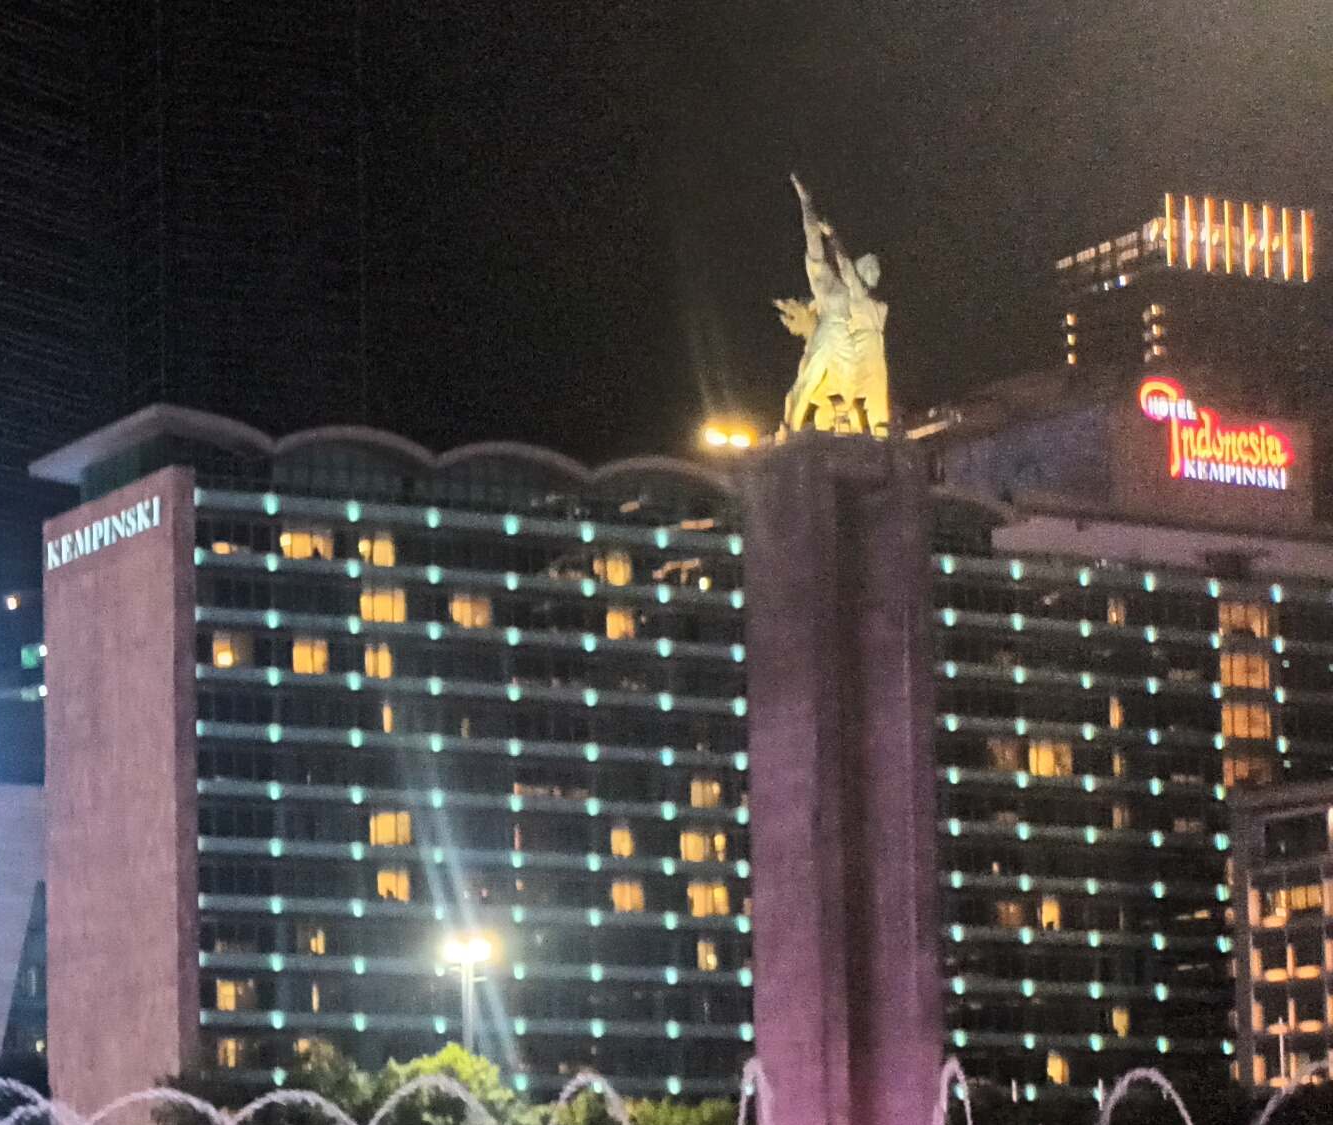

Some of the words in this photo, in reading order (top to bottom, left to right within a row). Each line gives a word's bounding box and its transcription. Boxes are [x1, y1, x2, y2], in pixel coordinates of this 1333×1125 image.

[1140, 378, 1288, 478] Indonesia
[1147, 395, 1197, 420] HOTEL
[1184, 459, 1286, 490] KEMPINSKI
[46, 495, 161, 571] KEMPINSKI
